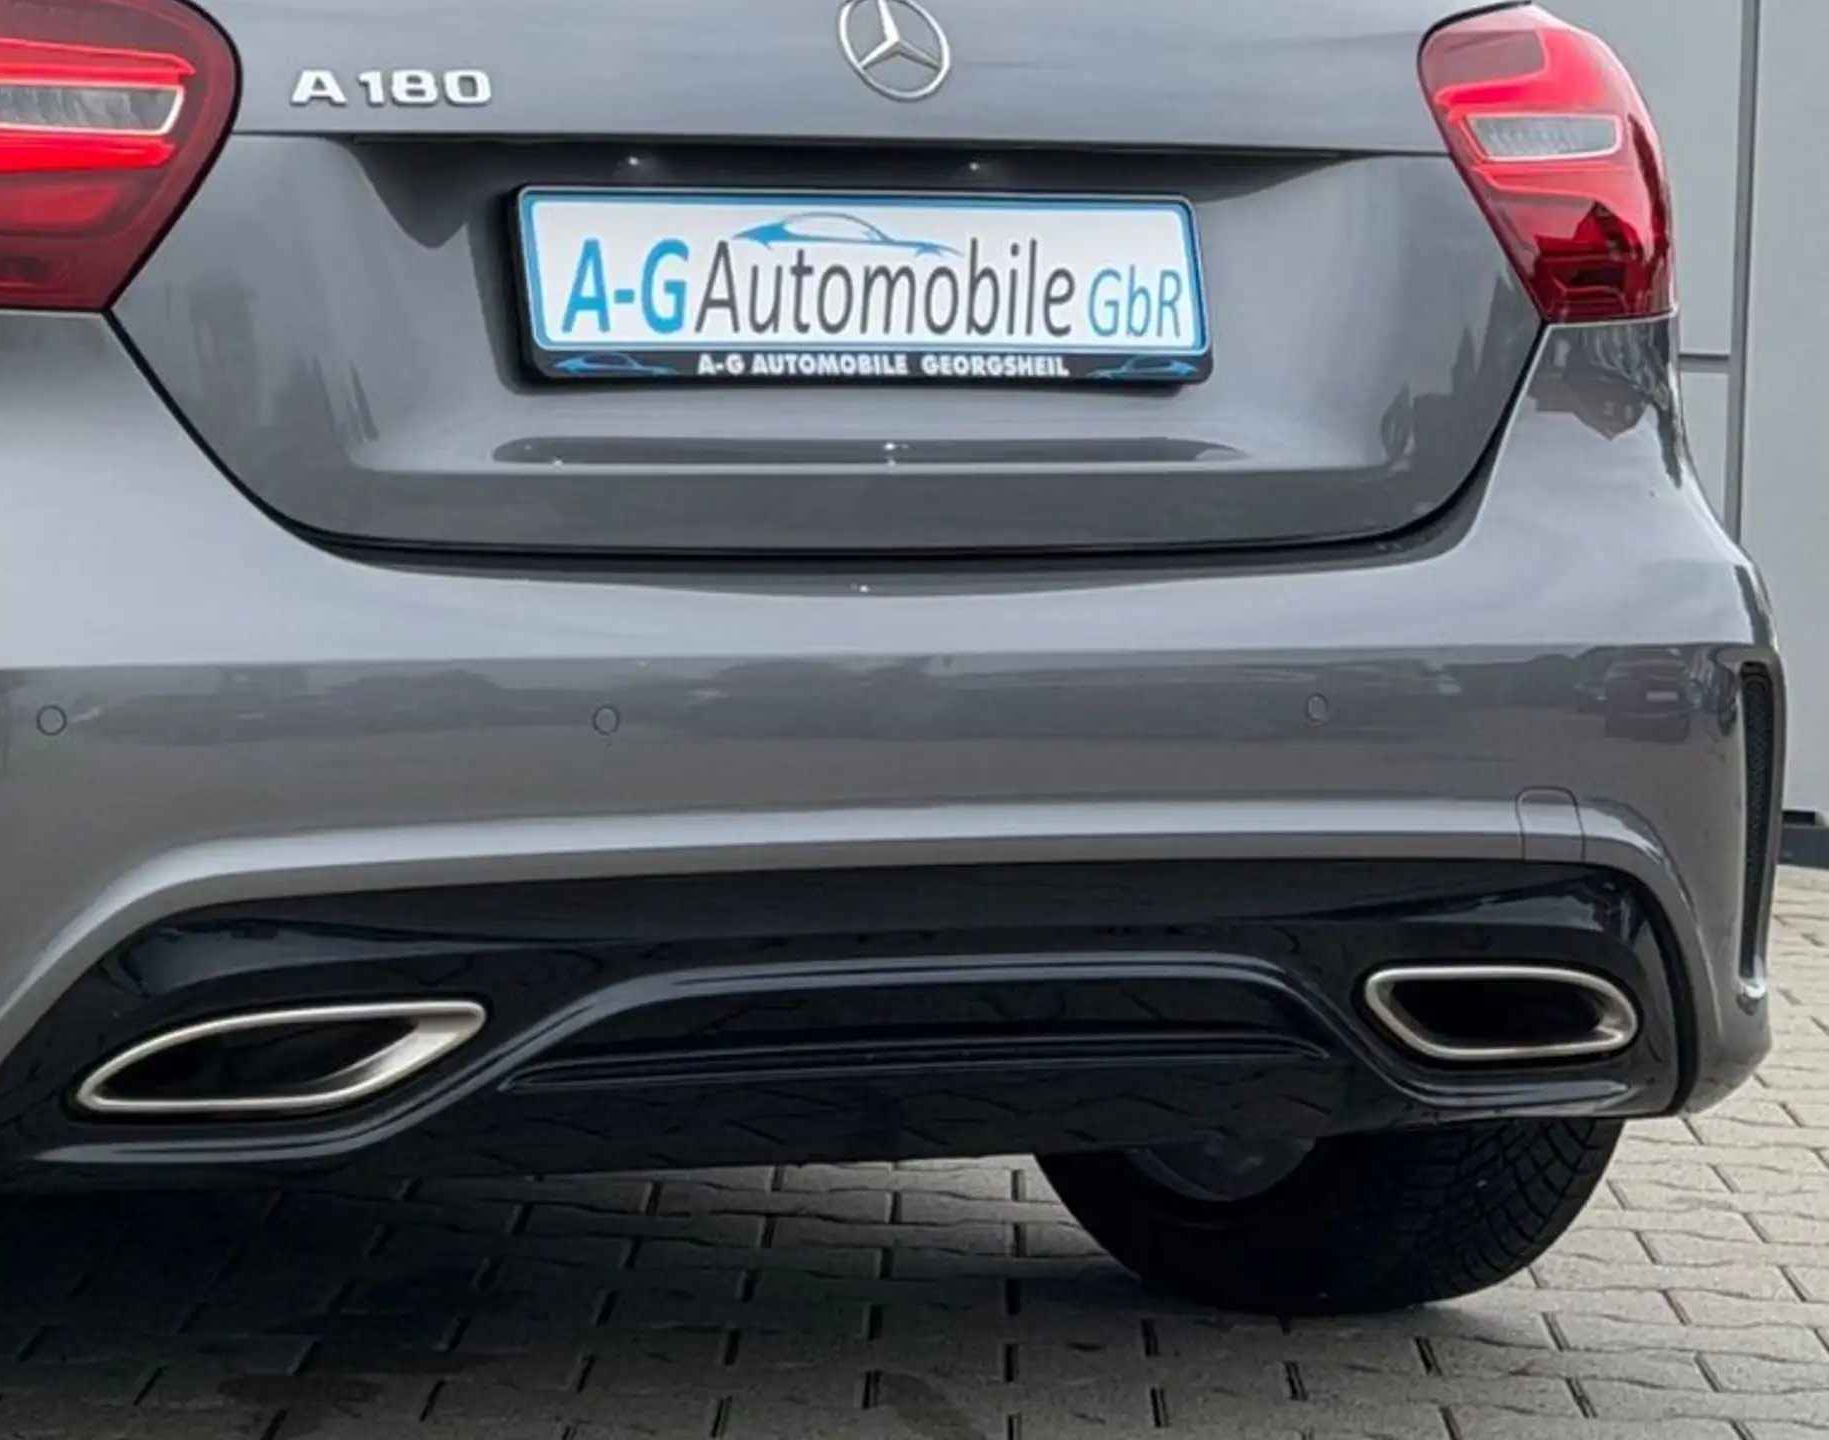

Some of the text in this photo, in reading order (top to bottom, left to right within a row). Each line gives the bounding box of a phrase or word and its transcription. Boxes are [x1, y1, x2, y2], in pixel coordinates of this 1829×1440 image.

[290, 68, 492, 106] A 180
[561, 236, 1182, 338] A-G Automobile GbR
[697, 352, 1071, 378] A-G AUTOMOBILE GEORGSHEIL
